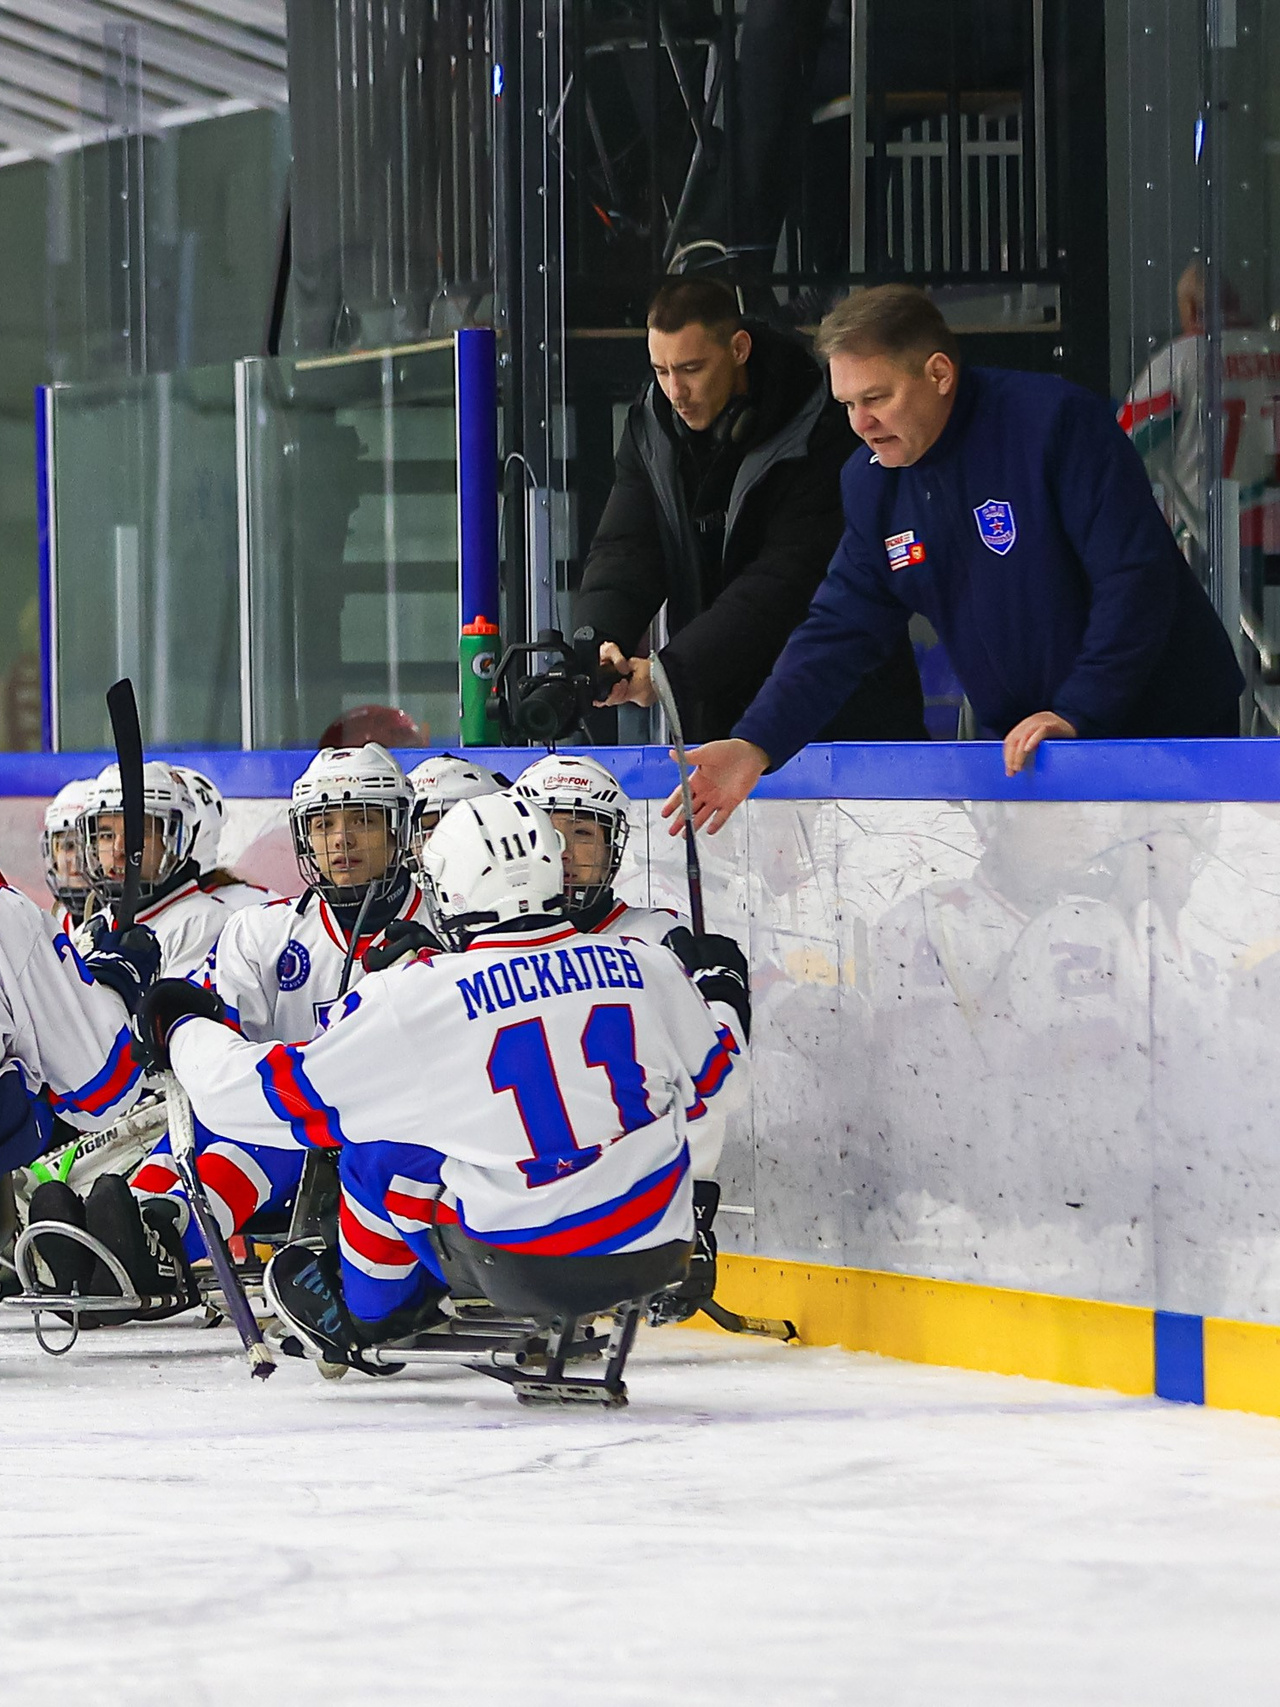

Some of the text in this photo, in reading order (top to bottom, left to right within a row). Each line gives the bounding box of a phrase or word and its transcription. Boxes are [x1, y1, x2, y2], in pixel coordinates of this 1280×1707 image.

[500, 833, 527, 861] 11
[455, 945, 644, 1021] МОСКАЛЕВ
[486, 1003, 659, 1189] 11
